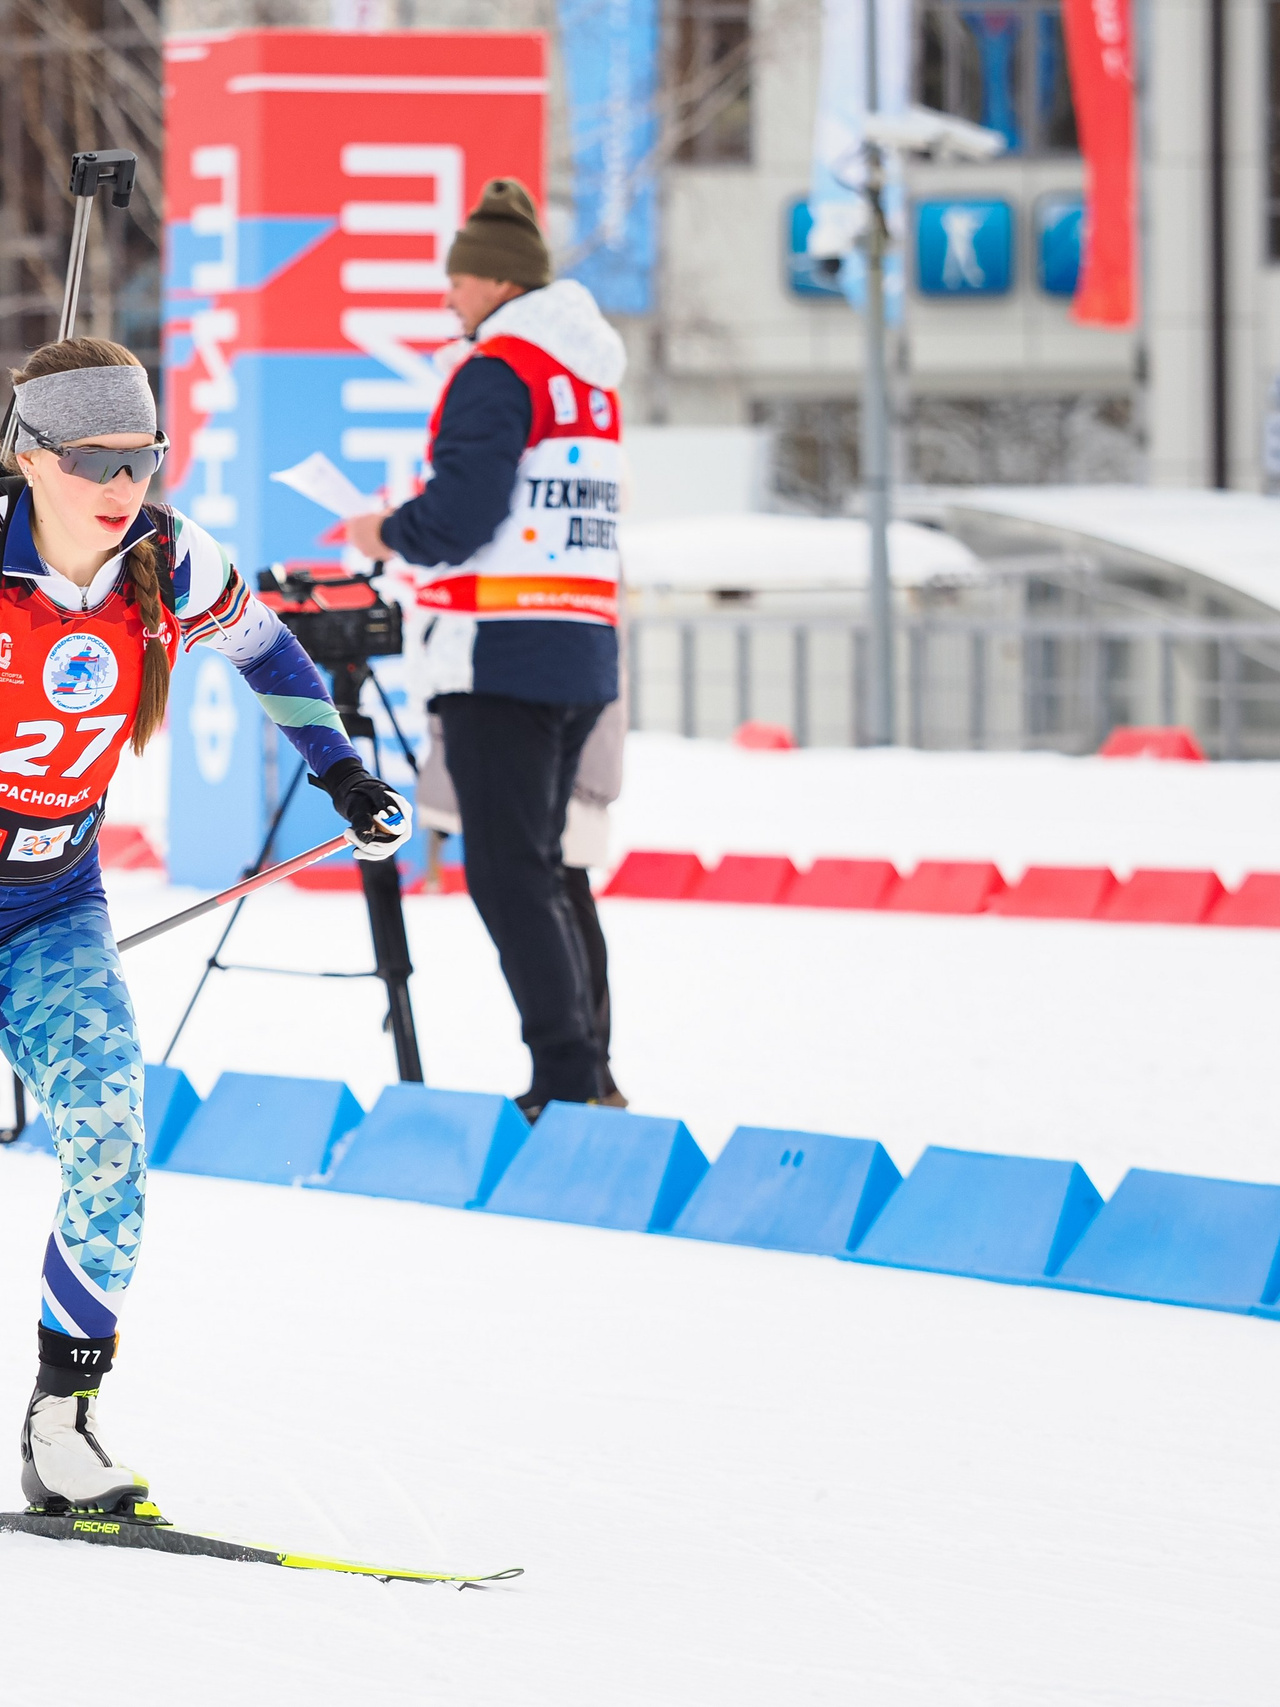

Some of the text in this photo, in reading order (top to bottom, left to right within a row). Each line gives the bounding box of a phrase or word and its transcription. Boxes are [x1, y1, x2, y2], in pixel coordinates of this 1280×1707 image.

[190, 145, 239, 784] ФНИШ
[340, 142, 465, 787] ФИШ
[49, 635, 111, 660] ПЕРВЕНСТВО РОССИИ
[70, 1348, 101, 1365] 177
[73, 1520, 121, 1534] FISCHER
